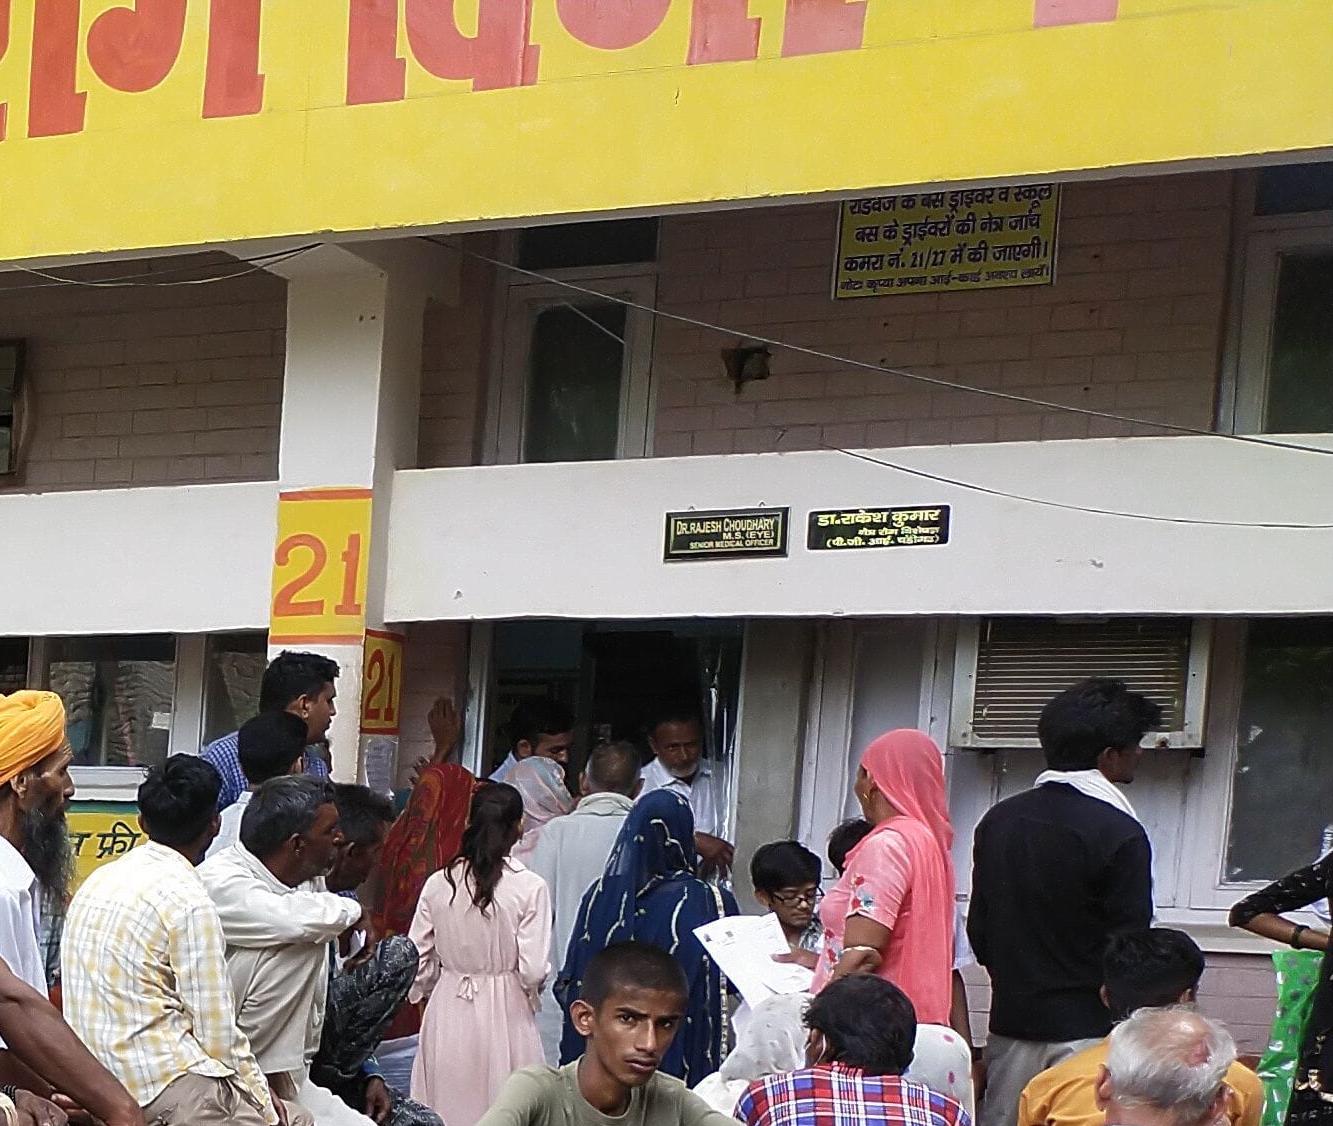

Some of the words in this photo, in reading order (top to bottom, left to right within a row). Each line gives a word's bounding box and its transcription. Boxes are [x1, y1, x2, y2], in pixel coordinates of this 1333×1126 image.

[883, 219, 898, 241] के
[956, 211, 977, 235] की
[980, 211, 1003, 232] नेत्र
[844, 254, 884, 272] कमरा
[949, 242, 967, 265] में
[967, 240, 988, 263] की
[723, 518, 774, 532] CHOUDHARY
[892, 510, 941, 527] कुमार
[689, 541, 714, 549] SENIOR
[715, 540, 743, 548] MEDICAL
[745, 538, 774, 546] OFFICER
[273, 533, 361, 616] 21
[365, 648, 396, 722] 21
